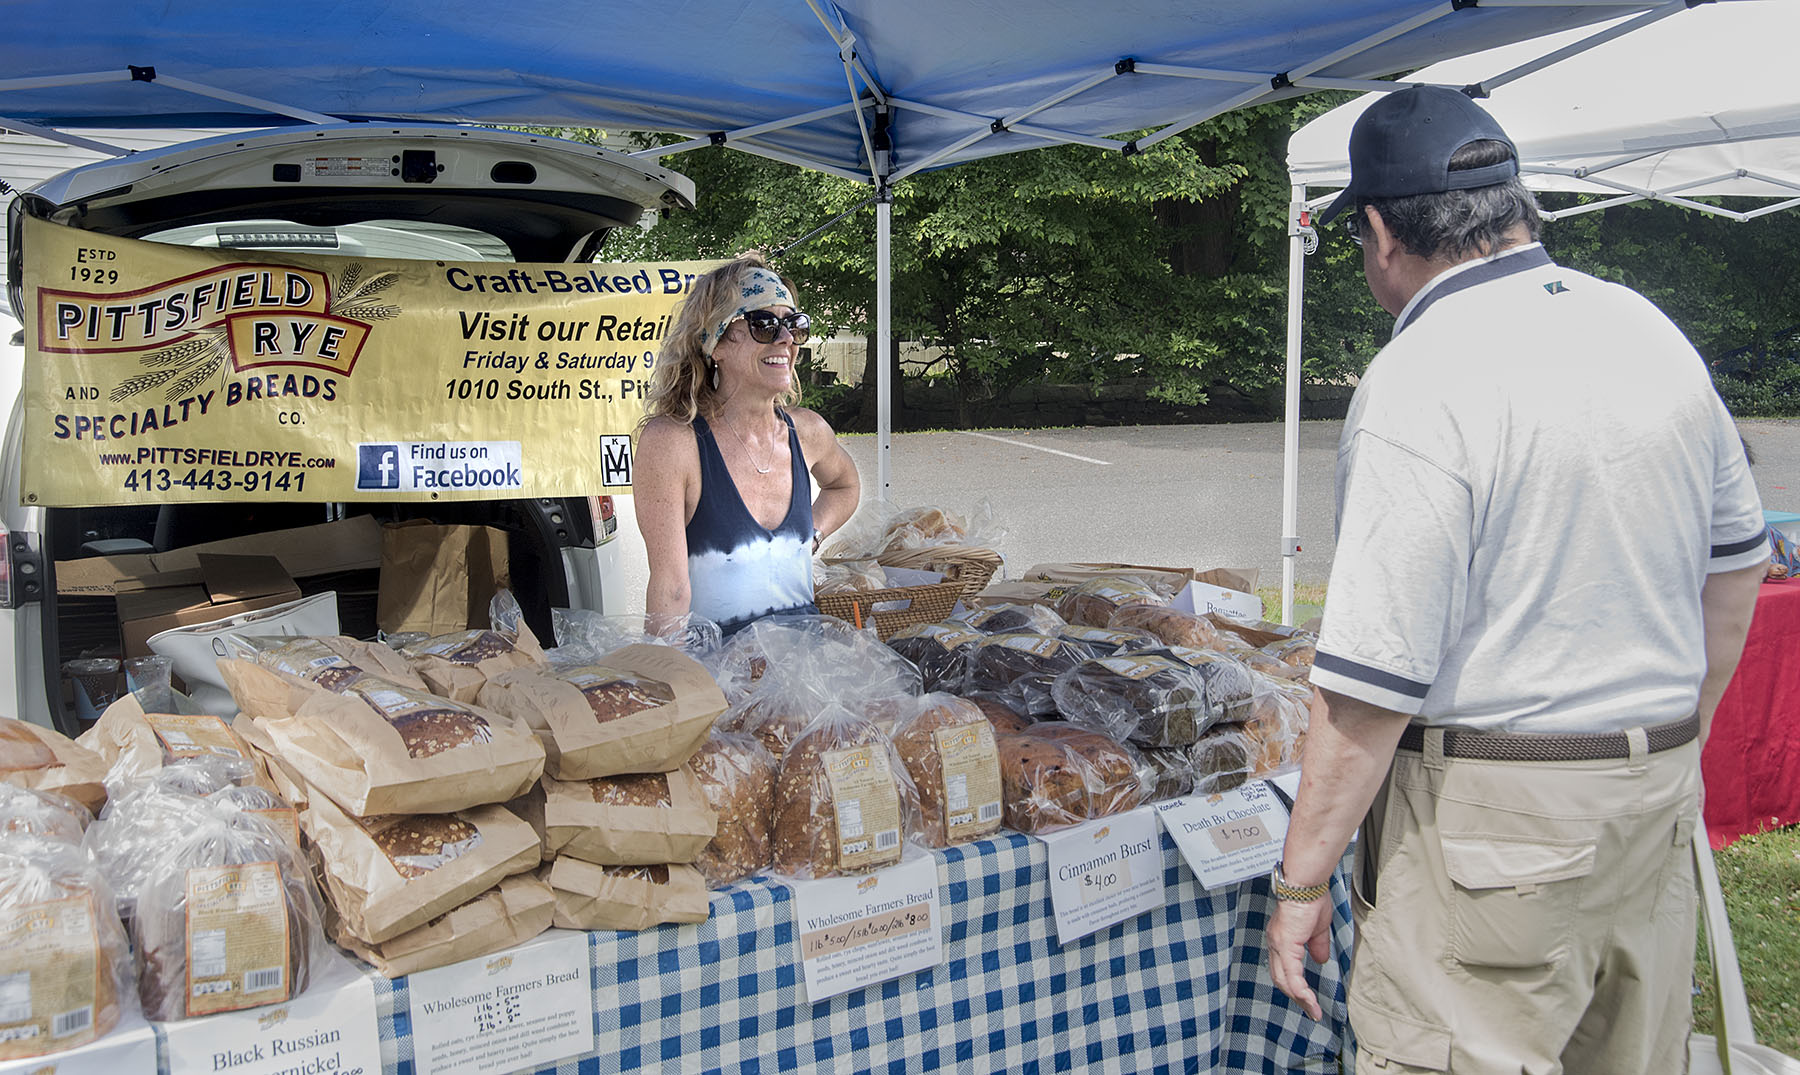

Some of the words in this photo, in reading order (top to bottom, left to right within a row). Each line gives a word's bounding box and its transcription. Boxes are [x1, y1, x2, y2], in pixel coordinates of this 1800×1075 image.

[77, 247, 117, 264] ESTD
[70, 265, 119, 285] 1929
[445, 266, 652, 294] Craft-Baked
[658, 268, 696, 295] Br
[57, 270, 313, 341] PITTSFIELD
[253, 320, 348, 361] RYE
[458, 311, 529, 342] Visit
[537, 319, 590, 342] our
[595, 314, 672, 341] Retail
[463, 351, 529, 374] Friday
[534, 351, 550, 370] &
[555, 352, 637, 374] Saturday
[643, 351, 655, 369] 9
[65, 386, 100, 401] AND
[445, 379, 499, 400] 1010
[506, 379, 571, 400] South
[578, 379, 614, 403] St.,
[621, 379, 651, 400] Pit
[53, 389, 216, 441] SPECIALTY
[226, 373, 338, 407] BREADS
[278, 411, 306, 426] CO.
[410, 443, 449, 460] Find
[451, 447, 467, 459] us
[470, 446, 488, 459] on
[124, 469, 305, 493] 413-443-9141
[412, 461, 522, 489] Facebook
[1182, 817, 1213, 833] Death
[1213, 814, 1226, 825] By
[1226, 802, 1271, 820] Chocolate
[1058, 851, 1117, 881] Cinnamon
[1120, 838, 1152, 859] Burst
[808, 906, 863, 930] Wholesome
[865, 900, 904, 916] Farmers
[906, 888, 933, 905] Bread
[423, 991, 492, 1015] Wholesome
[496, 979, 542, 998] Farmers
[546, 968, 579, 985] Bread
[212, 1044, 264, 1072] Black
[271, 1028, 341, 1056] Russian
